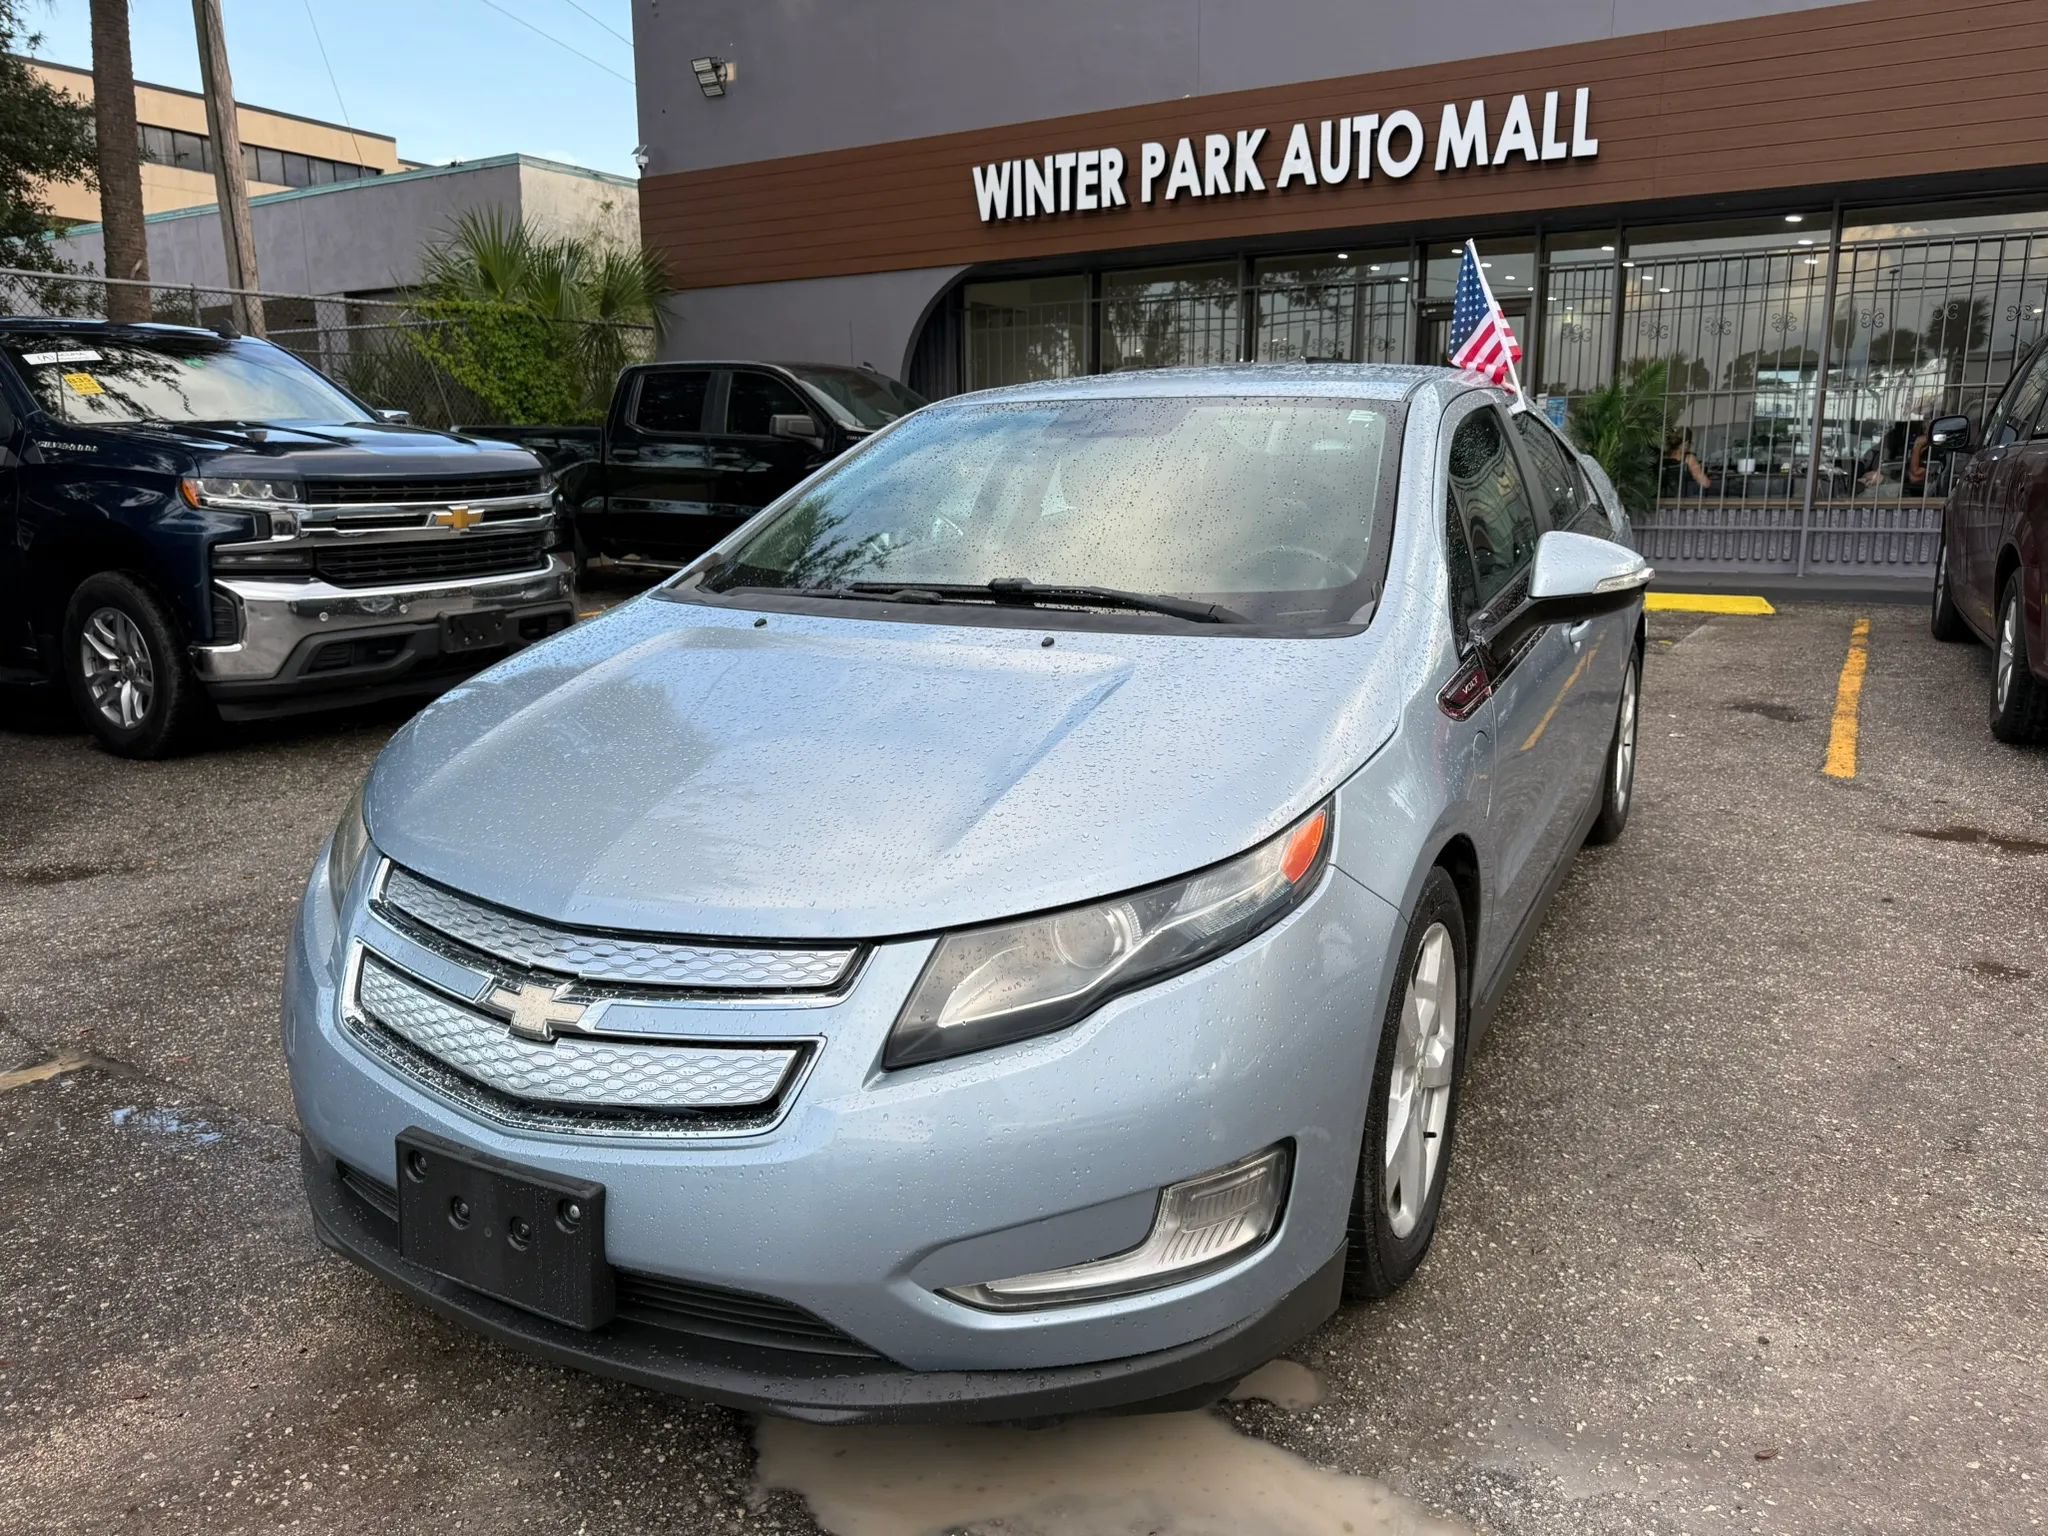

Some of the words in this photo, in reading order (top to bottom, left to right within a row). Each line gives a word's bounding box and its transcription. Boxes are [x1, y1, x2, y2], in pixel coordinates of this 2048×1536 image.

[972, 147, 1126, 222] WINTER
[1141, 128, 1267, 203] PARK
[1276, 109, 1424, 188] AUTO
[1434, 87, 1599, 171] MALL
